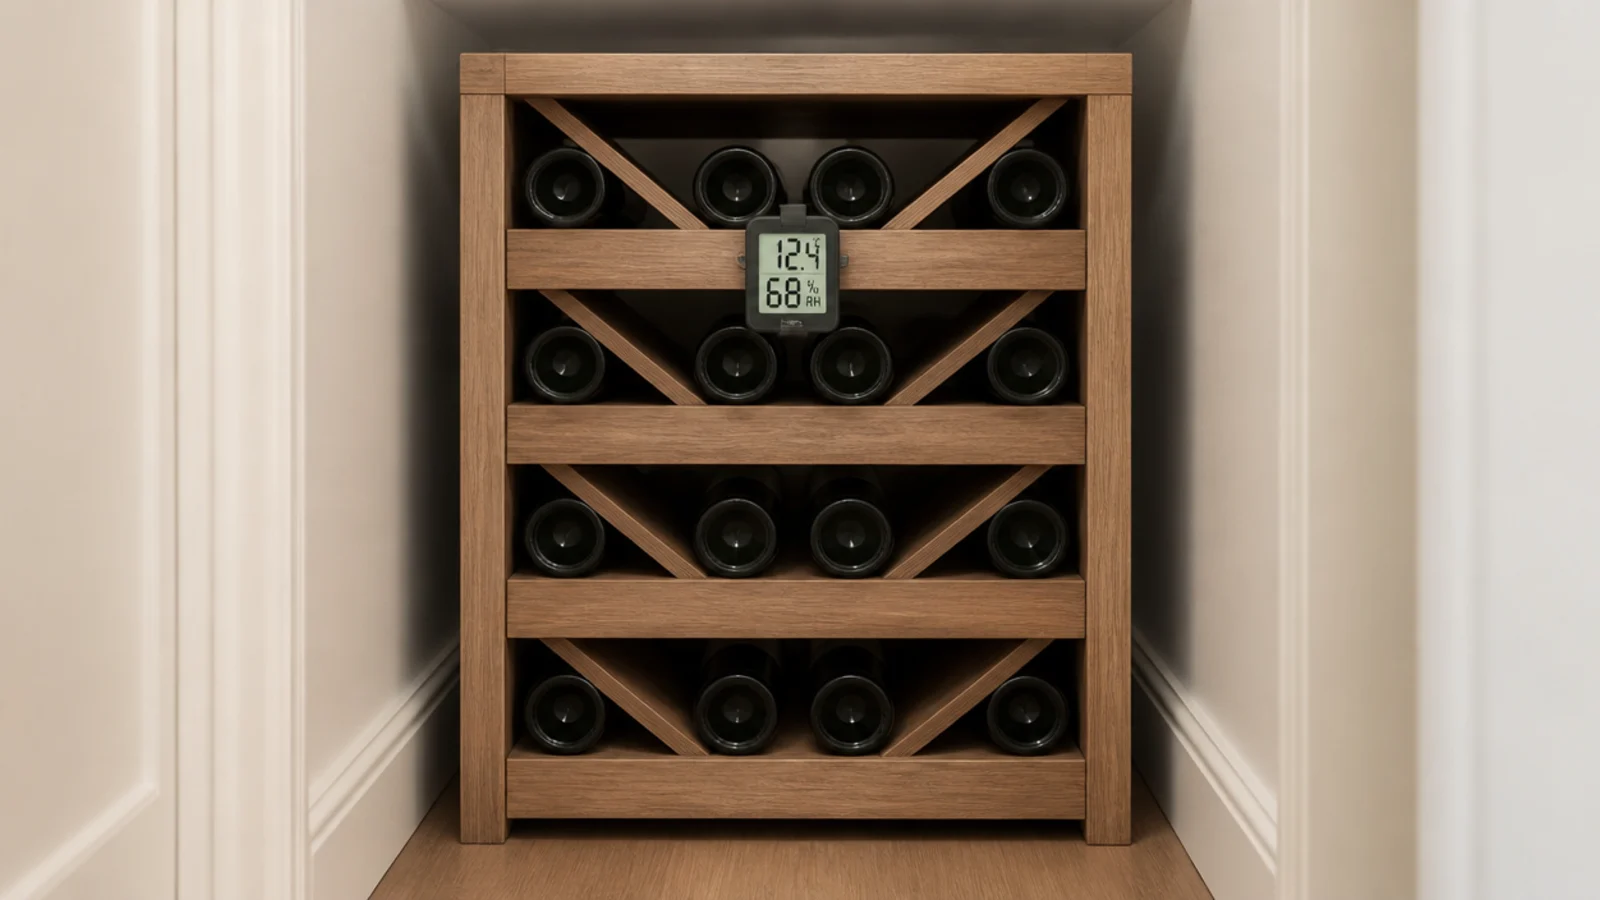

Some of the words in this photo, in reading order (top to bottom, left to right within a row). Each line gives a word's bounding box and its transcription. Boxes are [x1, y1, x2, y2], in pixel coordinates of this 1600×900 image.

[777, 238, 820, 270] 12.4
[766, 277, 801, 308] 68
[806, 296, 821, 307] RH
